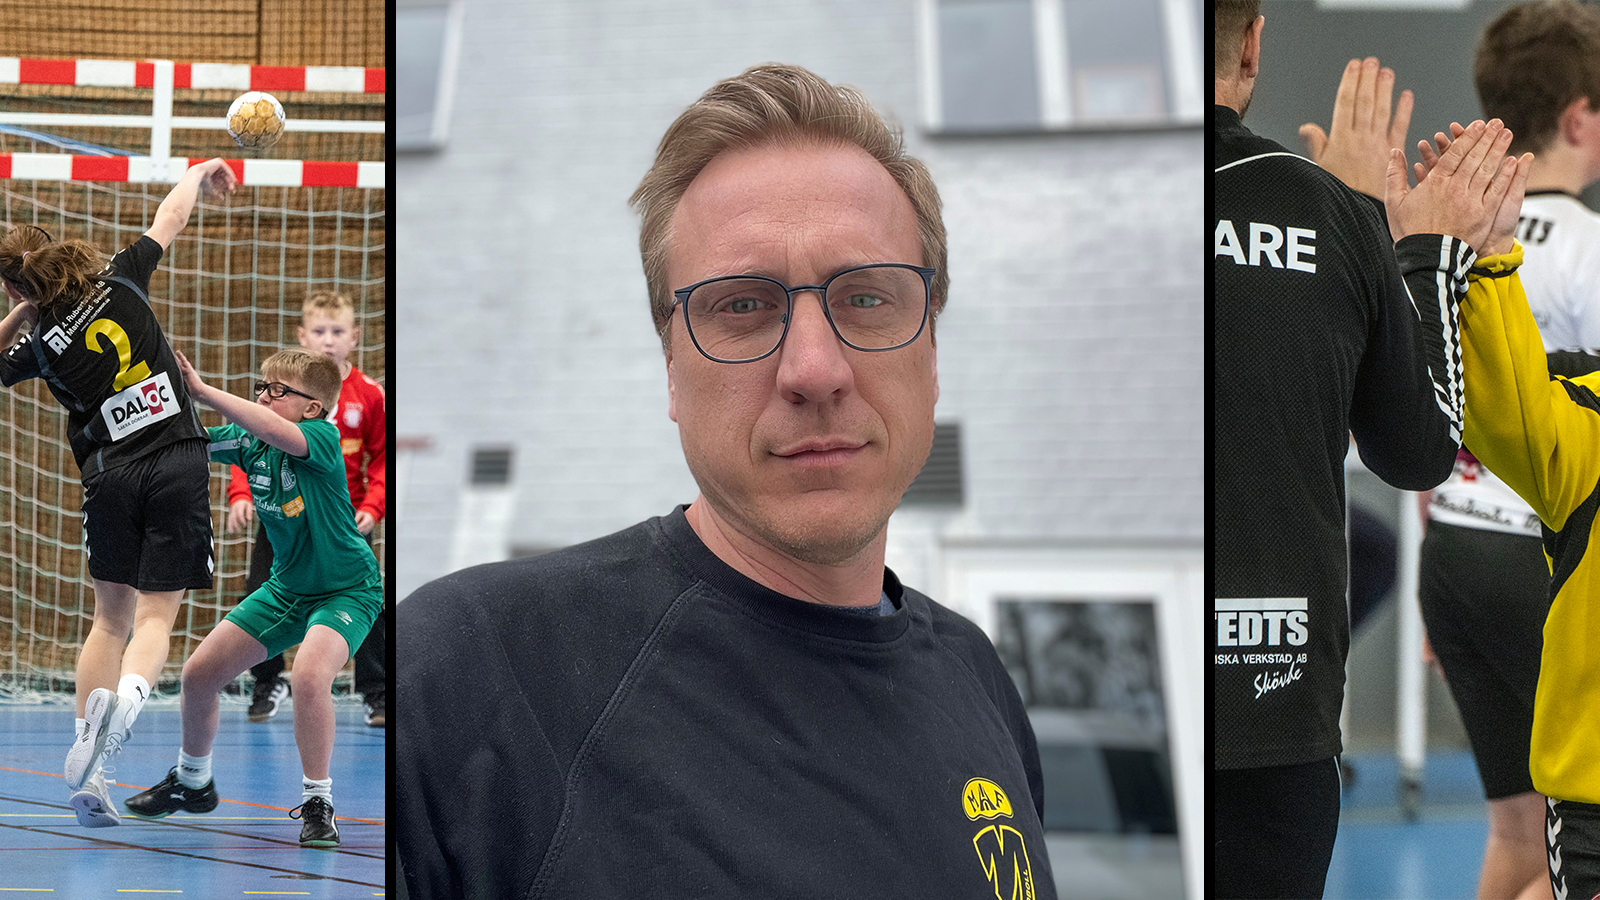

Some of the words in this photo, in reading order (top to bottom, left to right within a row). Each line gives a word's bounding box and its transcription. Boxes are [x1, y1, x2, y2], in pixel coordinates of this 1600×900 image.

[1215, 219, 1317, 274] ARE
[95, 280, 106, 290] AB
[66, 304, 94, 336] Mariestad
[85, 318, 152, 392] 2
[110, 385, 170, 425] DALOC
[1215, 610, 1309, 647] EDTS
[1242, 653, 1293, 664] VERKSTAD
[1296, 653, 1308, 664] AB
[1253, 661, 1303, 700] Skövde
[967, 783, 1005, 813] MAF
